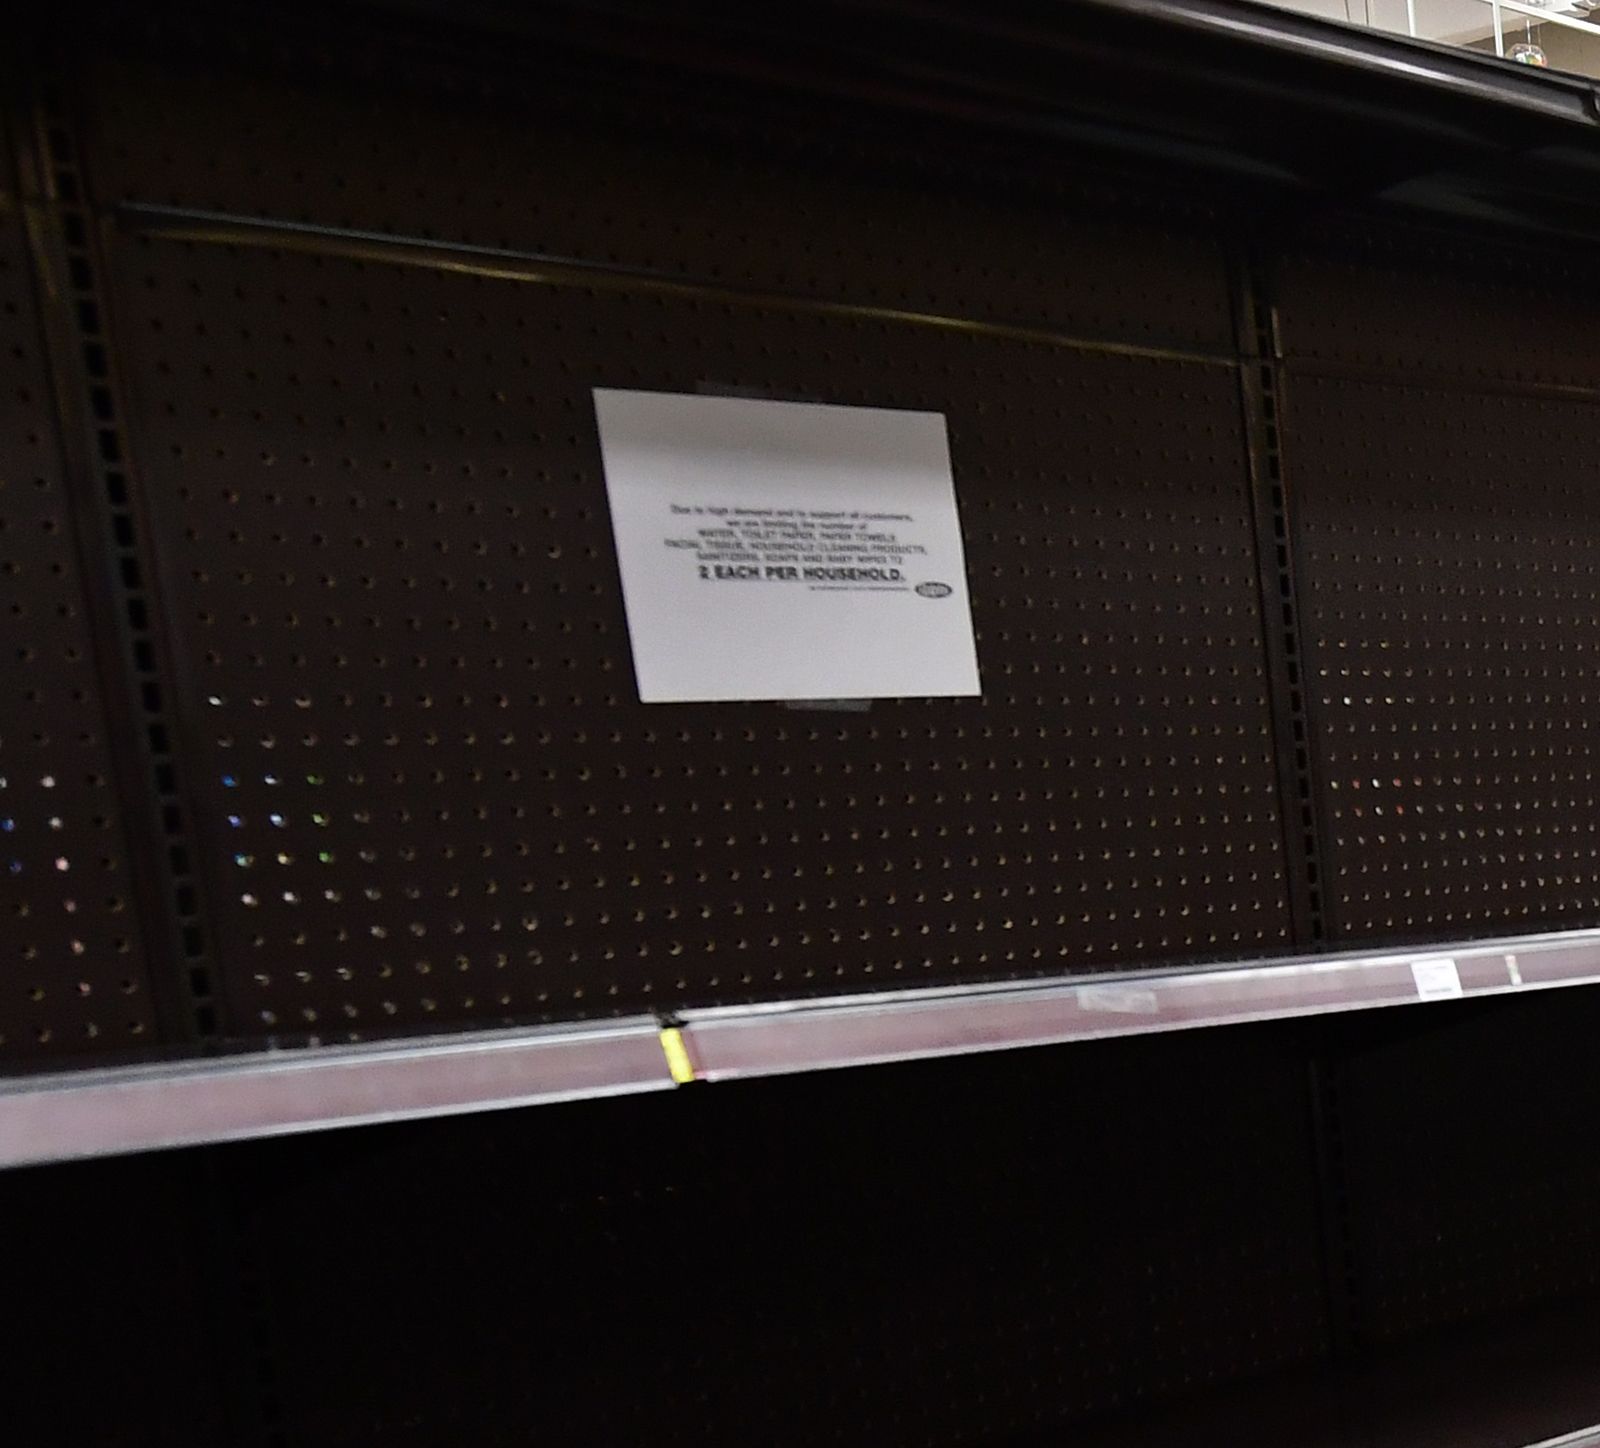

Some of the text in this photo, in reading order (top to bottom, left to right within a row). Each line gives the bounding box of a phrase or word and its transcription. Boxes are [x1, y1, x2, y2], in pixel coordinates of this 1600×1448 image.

[715, 566, 760, 580] EACH
[766, 566, 798, 580] PER
[803, 567, 906, 582] HOUSEHOLD.
